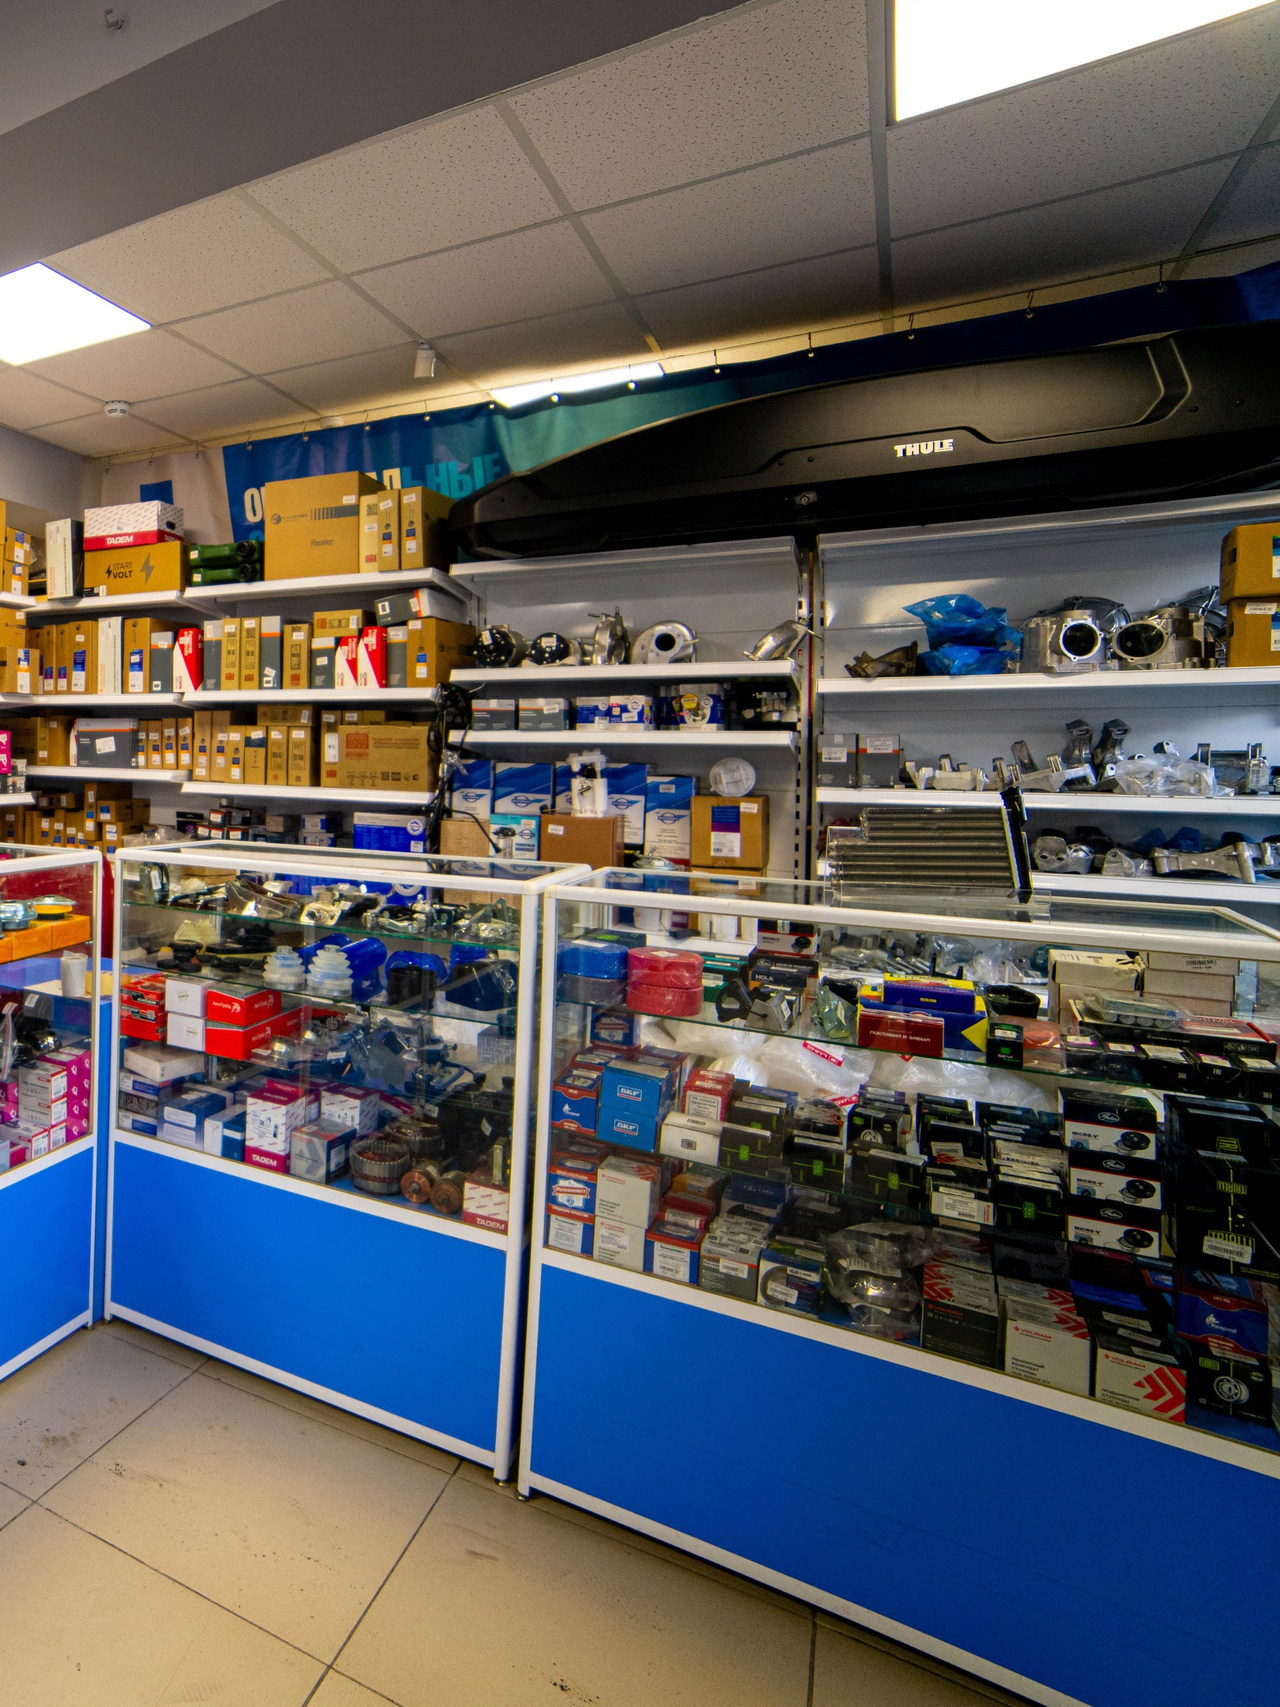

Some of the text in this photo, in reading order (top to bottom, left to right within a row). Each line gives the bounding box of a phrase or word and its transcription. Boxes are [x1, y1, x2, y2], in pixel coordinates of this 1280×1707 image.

[894, 439, 954, 457] THULE
[106, 535, 134, 545] TADEM
[112, 562, 133, 570] START
[112, 570, 133, 579] VOLT
[755, 974, 774, 982] HOLA
[869, 1030, 902, 1039] ПОСТАВИЛ
[619, 1088, 640, 1096] SKF
[616, 1122, 637, 1131] SKF
[252, 1154, 278, 1167] TADEM
[476, 1218, 505, 1231] TADEM
[1020, 1327, 1052, 1340] VOLRAM
[1111, 1356, 1146, 1369] VOLRAM
